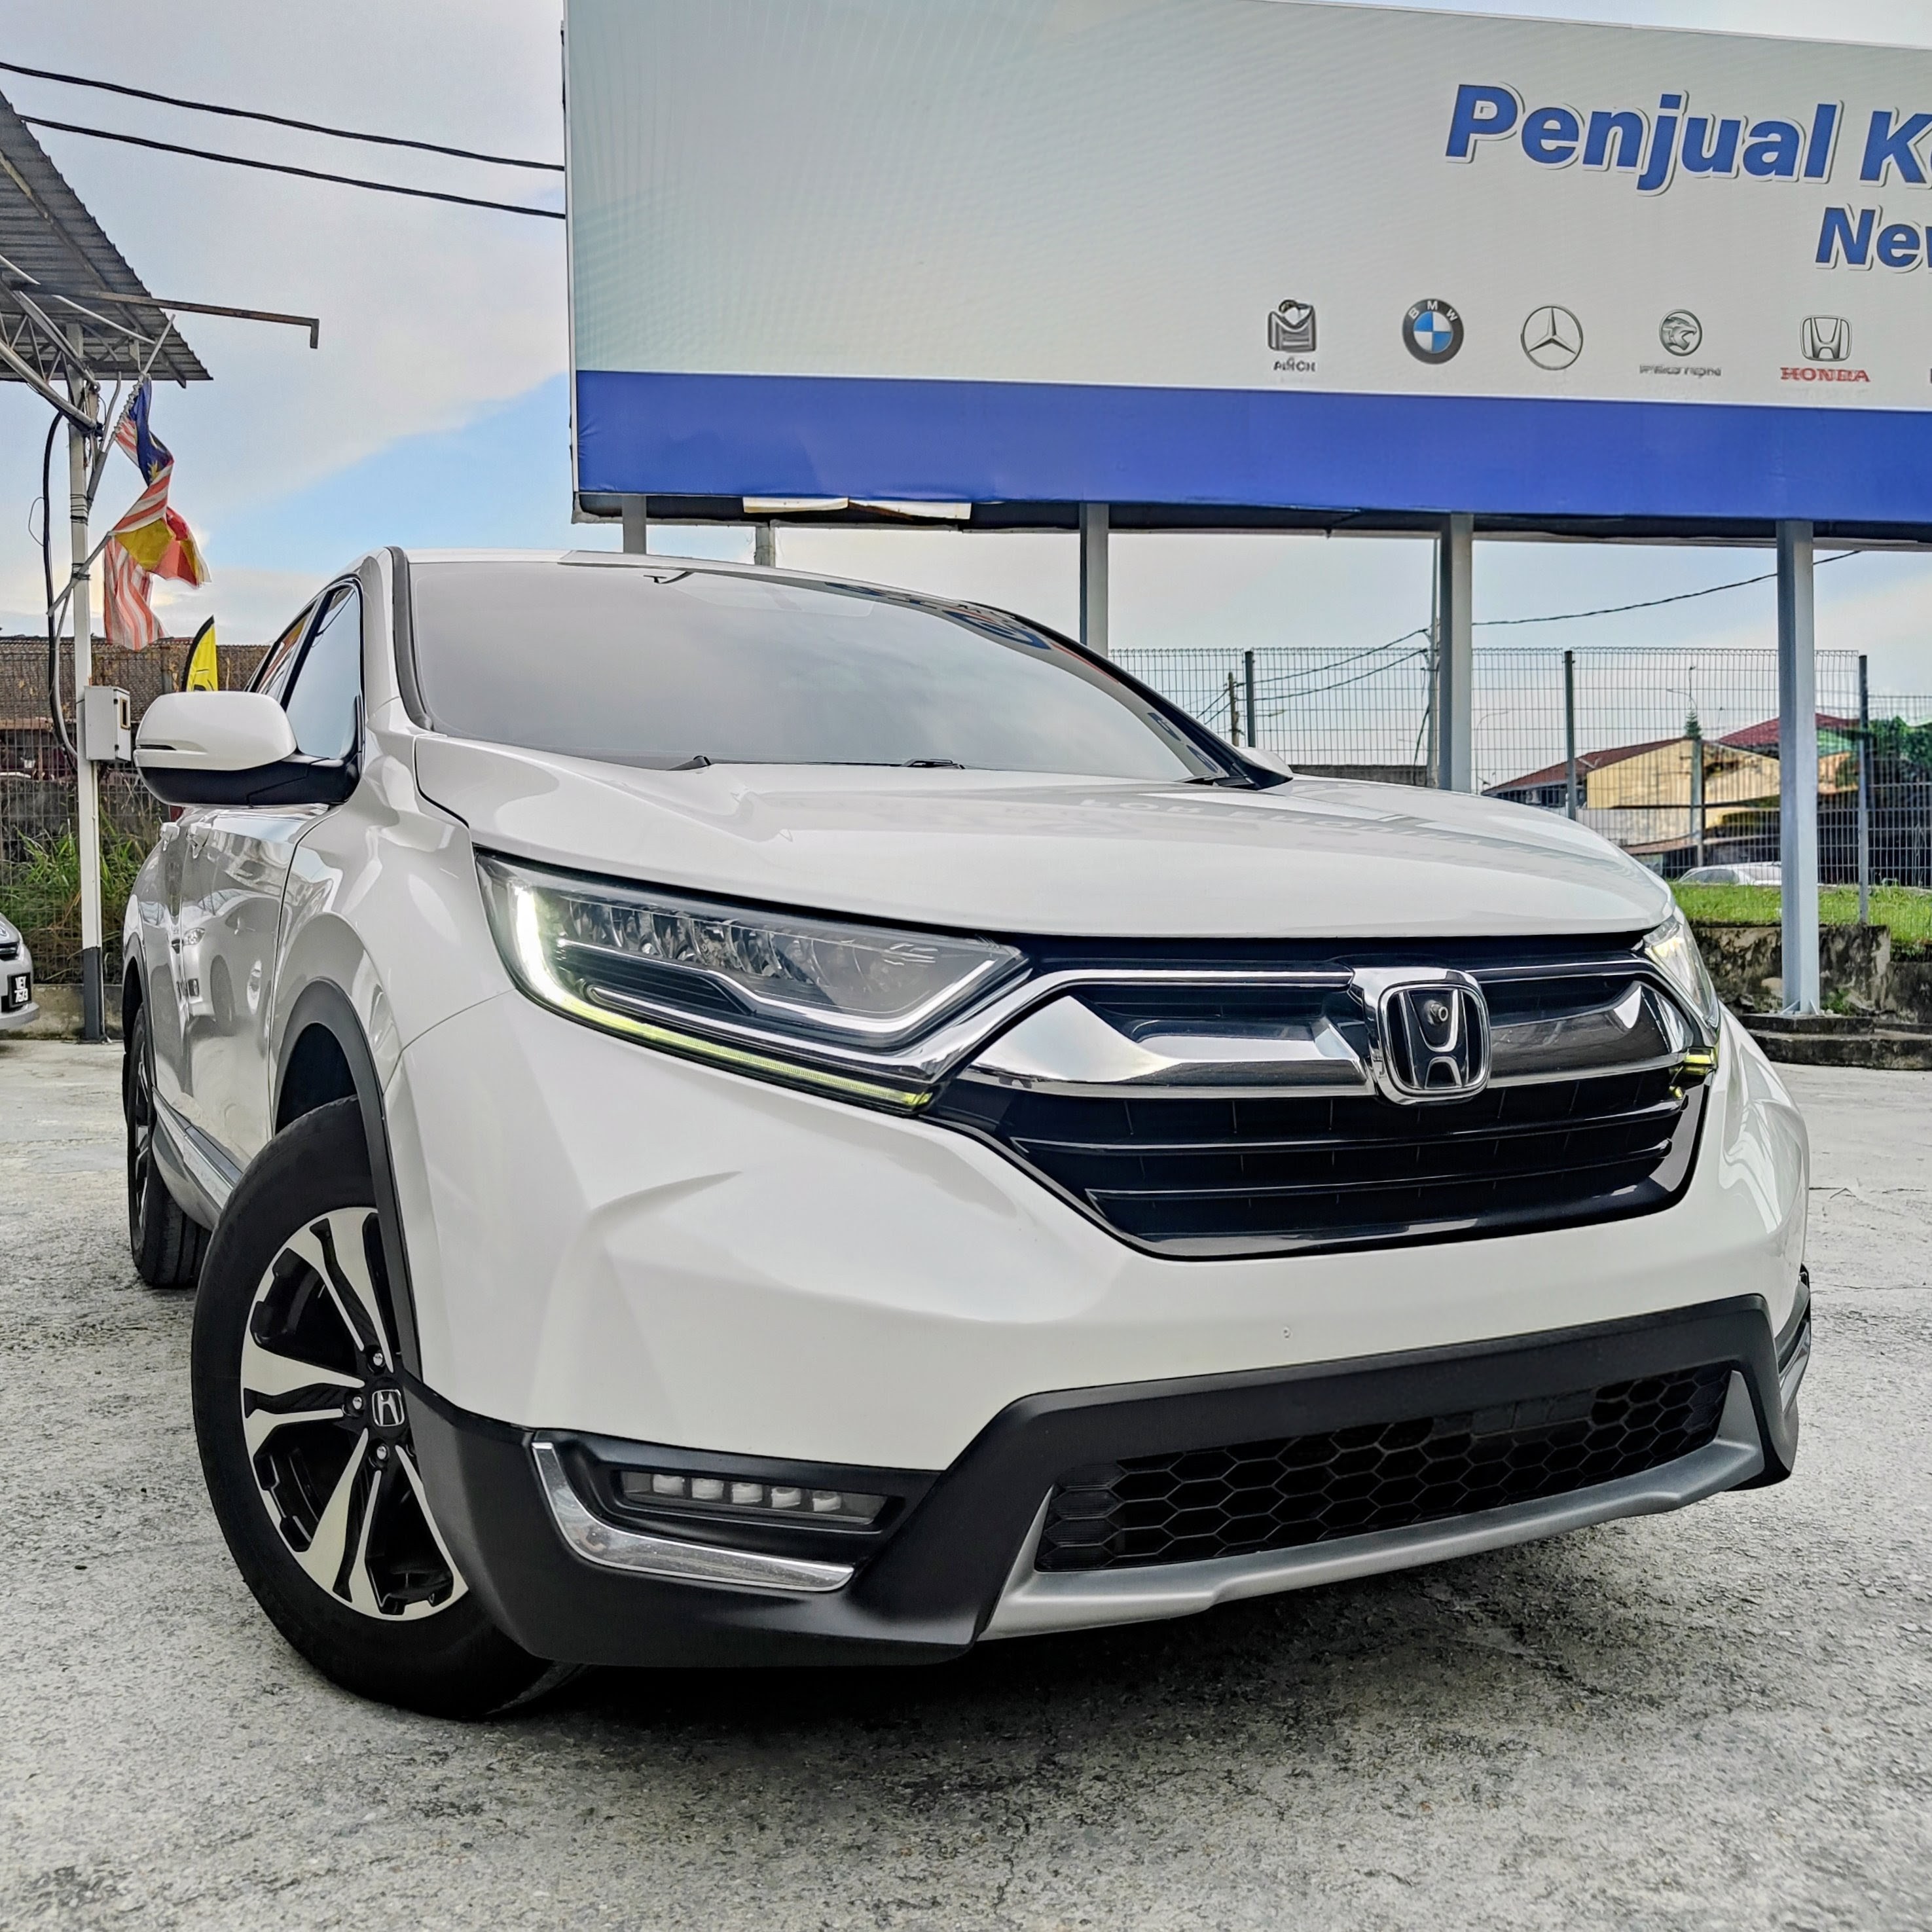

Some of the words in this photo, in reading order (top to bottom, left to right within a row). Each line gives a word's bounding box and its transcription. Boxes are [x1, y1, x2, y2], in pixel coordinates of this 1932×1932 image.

[1444, 83, 1840, 192] Penjual
[1859, 110, 1932, 185] K
[1815, 206, 1932, 268] Ne
[1408, 300, 1458, 321] BMW
[1779, 367, 1871, 382] HONDA
